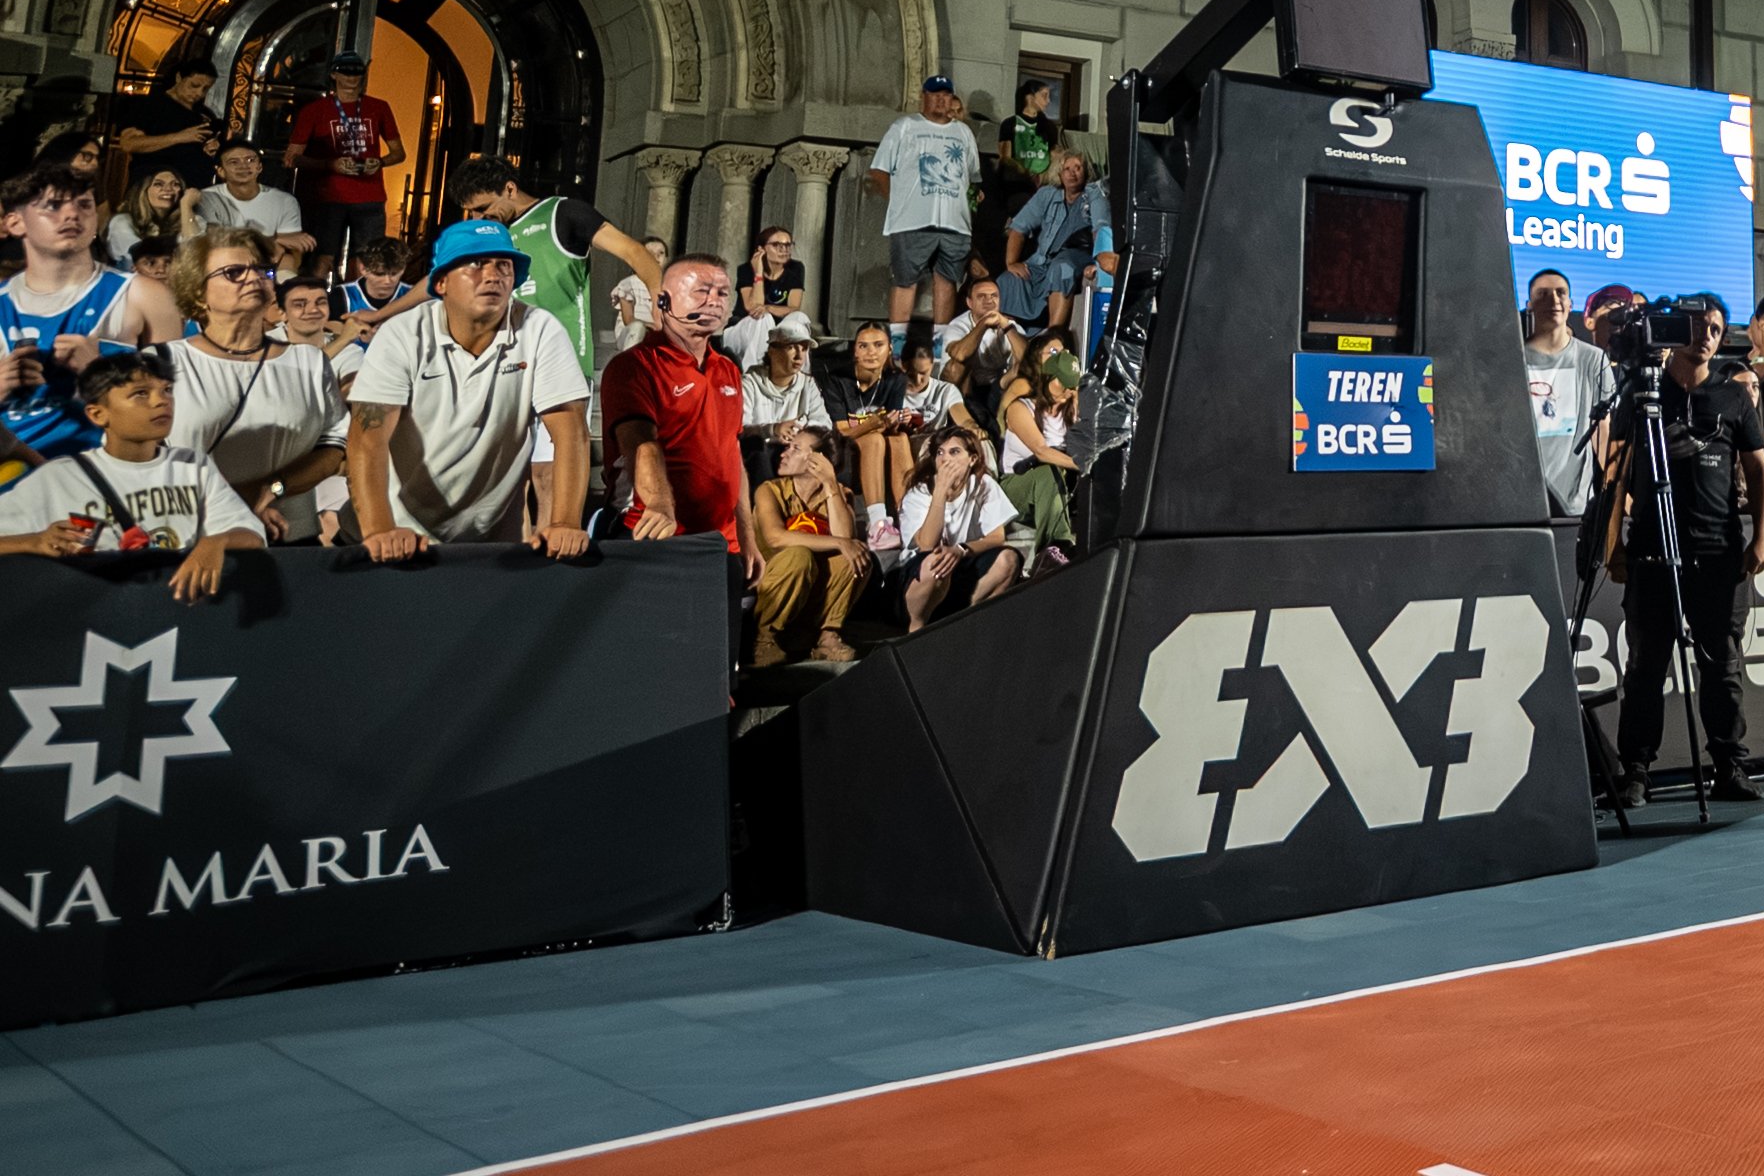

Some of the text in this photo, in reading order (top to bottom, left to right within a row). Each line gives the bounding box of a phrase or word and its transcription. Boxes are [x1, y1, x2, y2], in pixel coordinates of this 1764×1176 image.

[1324, 147, 1407, 165] Schelde Sports
[1506, 142, 1614, 209] BCR
[1505, 207, 1624, 259] Leasing
[1327, 370, 1404, 403] TEREN
[1317, 423, 1379, 455] BCR
[147, 823, 450, 917] MARIA
